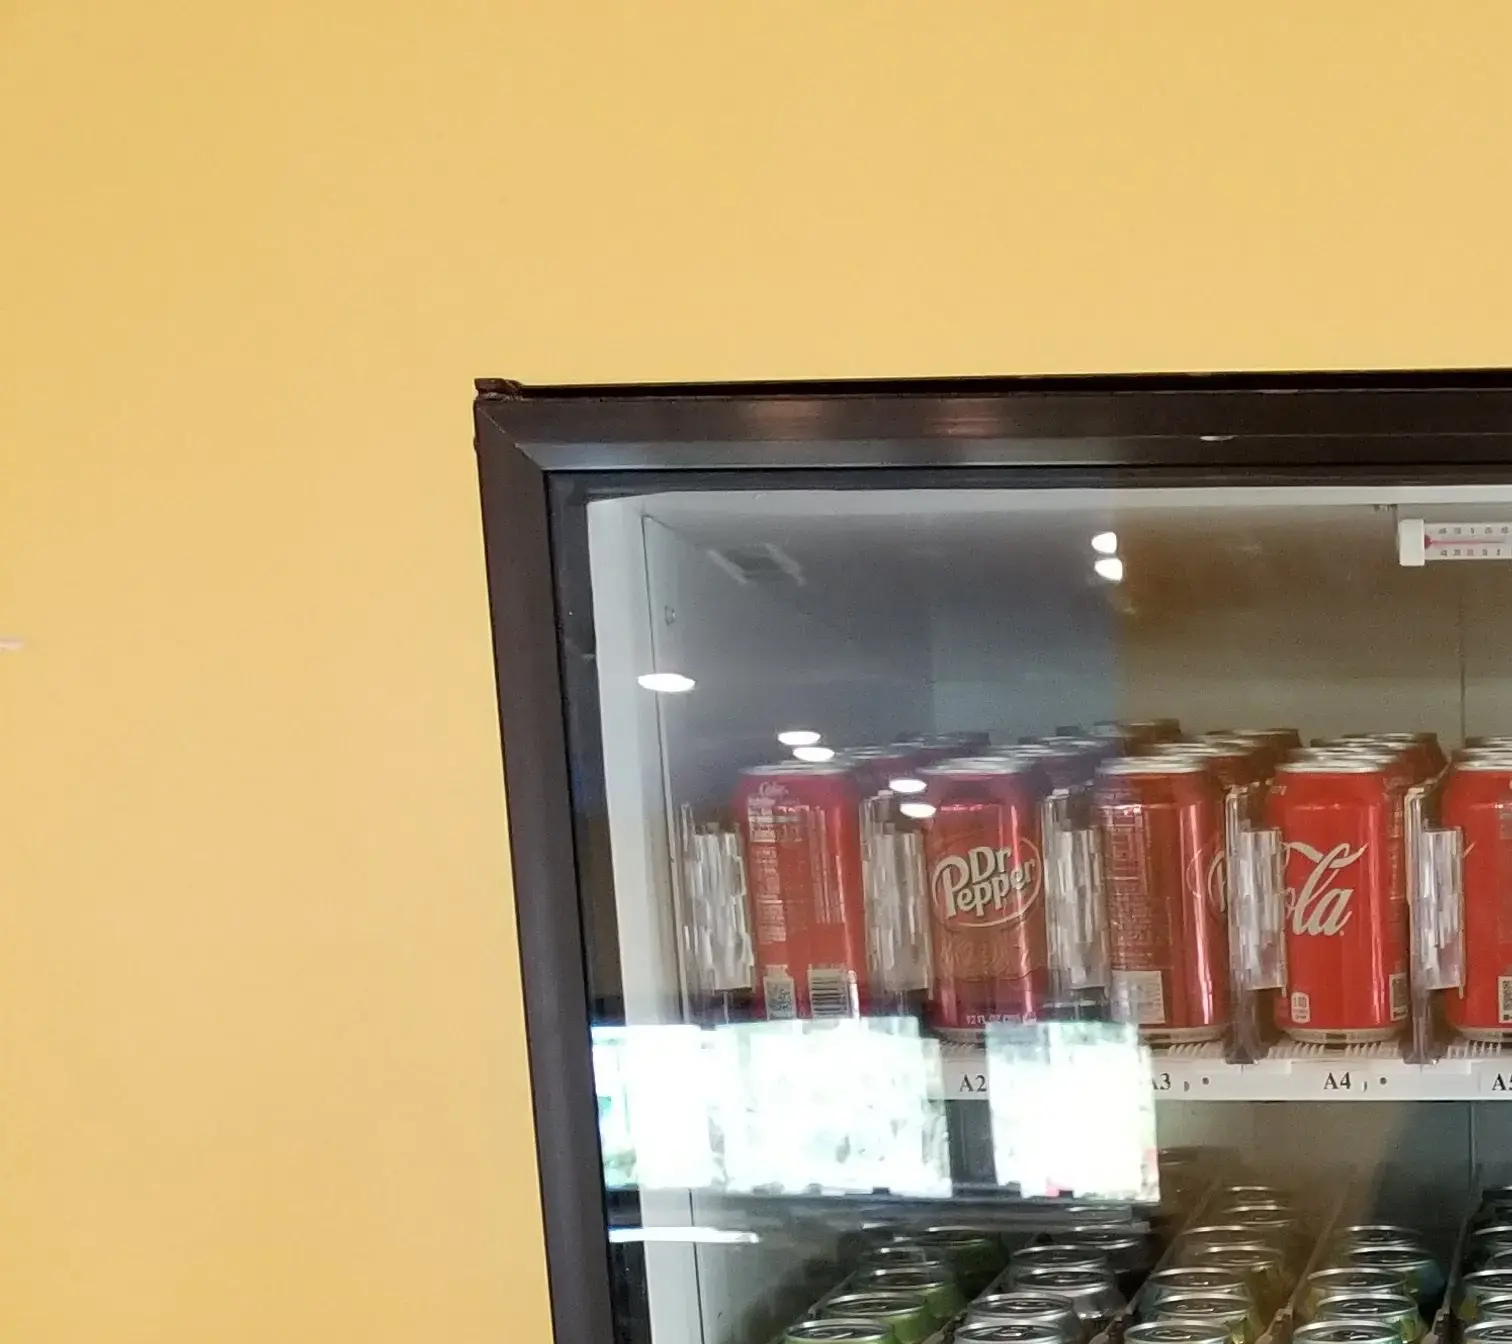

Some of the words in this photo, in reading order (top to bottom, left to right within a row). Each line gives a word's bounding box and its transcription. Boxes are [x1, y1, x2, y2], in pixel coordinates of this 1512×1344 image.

[969, 846, 1012, 877] Dr
[933, 854, 1037, 921] Pepper
[959, 1074, 987, 1093] A2
[1324, 1072, 1351, 1090] A4
